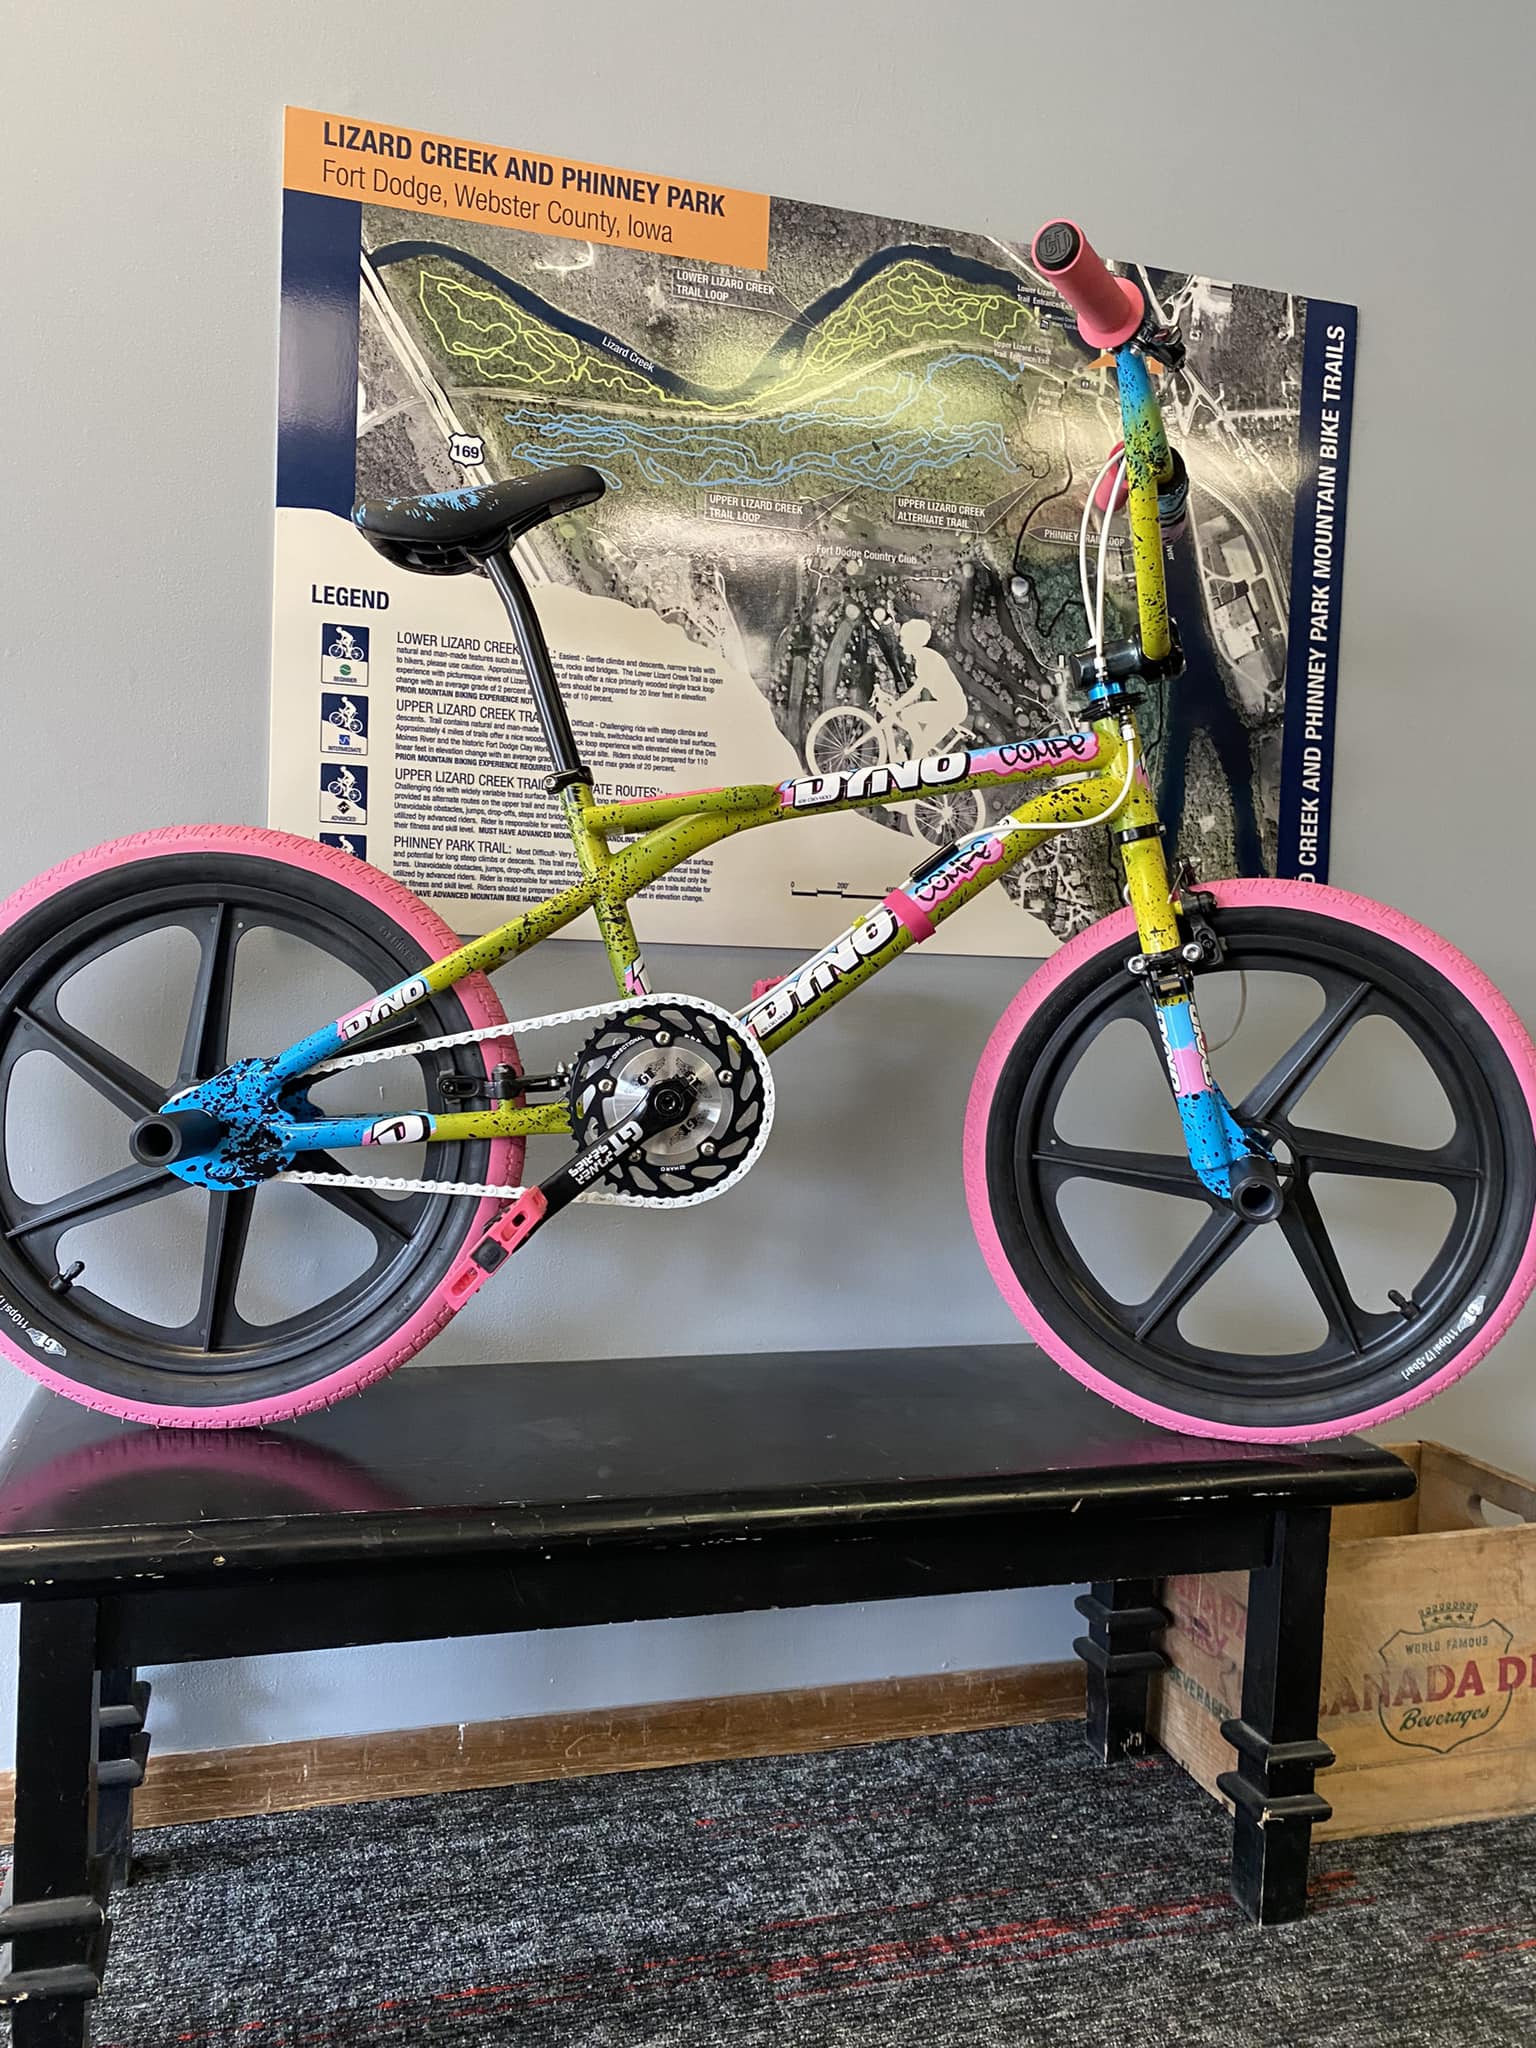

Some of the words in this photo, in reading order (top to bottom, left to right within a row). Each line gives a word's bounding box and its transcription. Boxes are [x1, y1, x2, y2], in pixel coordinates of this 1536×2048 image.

[324, 121, 412, 160] LIZARD
[421, 141, 498, 177] CREEK
[505, 157, 553, 186] AND
[562, 167, 660, 204] PHINNEY
[667, 186, 726, 217] PARK
[323, 159, 365, 189] Fort
[374, 168, 447, 208] Dodge,
[455, 183, 540, 220] Webster
[547, 200, 620, 238] County,
[628, 214, 672, 243] Iowa
[677, 270, 708, 285] LOWER
[711, 277, 743, 290] LIZARD
[746, 282, 775, 296] CREEK
[677, 285, 702, 297] TRAIL
[705, 289, 729, 301] LOOP
[602, 336, 629, 357] Lizard
[629, 353, 655, 373] Creek
[1323, 325, 1346, 402] TRAILS
[1319, 409, 1339, 460] BIKE
[453, 445, 479, 459] 169
[710, 494, 738, 507] UPPER
[741, 498, 772, 511] LIZARD
[774, 503, 803, 515] CREEK
[710, 508, 735, 519] TRAIL
[737, 512, 761, 523] LOOP
[898, 498, 926, 510] UPPER
[928, 502, 957, 514] LIZARD
[958, 506, 986, 517] CREEK
[898, 511, 944, 526] ALTERNATE
[946, 517, 970, 529] TRAIL
[1312, 465, 1337, 579] MOUNTAIN
[1044, 529, 1079, 541] PHINNEY
[1108, 537, 1124, 546] OOP
[817, 544, 832, 554] Fort
[836, 546, 862, 559] Dodge
[864, 550, 896, 564] Country
[898, 553, 917, 564] Club
[312, 584, 390, 610] LEGEND
[1310, 584, 1331, 642] PARK
[397, 632, 437, 646] LOWER
[441, 636, 480, 651] LIZARD
[484, 641, 520, 655] CREEK
[396, 686, 416, 694] PRIOR
[418, 687, 453, 697] MOUNTAIN
[455, 691, 477, 700] BIKING
[479, 693, 519, 704] EXPERIENCE
[1305, 647, 1327, 740] PHINNEY
[396, 699, 433, 714] UPPER
[437, 703, 476, 717] LIZARD
[480, 706, 516, 721] CREEK
[395, 723, 440, 735] Approximately
[448, 728, 464, 736] miles
[473, 730, 488, 738] trails
[600, 721, 633, 733] Challenging
[395, 734, 418, 742] Moines
[420, 735, 435, 743] River
[462, 739, 484, 747] historic
[500, 742, 518, 751] Dodge
[520, 744, 532, 752] Clay
[1000, 735, 1086, 766] COMPE
[395, 753, 416, 761] PRIOR
[417, 755, 453, 764] MOUNTAIN
[454, 758, 477, 766] BIKING
[479, 760, 518, 770] EXPERIENCE
[1302, 747, 1322, 792] AND
[395, 768, 432, 782] UPPER
[435, 771, 475, 785] LIZARD
[479, 774, 514, 788] CREEK
[794, 752, 970, 806] DYNO
[395, 782, 431, 793] Challenging
[461, 788, 481, 797] widely
[482, 789, 506, 797] variable
[524, 792, 546, 800] surface
[478, 827, 497, 835] MUST
[499, 828, 515, 836] HAVE
[518, 829, 551, 838] ADVANCED
[1298, 797, 1319, 866] CREEK
[394, 836, 443, 850] PHINNEY
[446, 839, 475, 852] PARK
[478, 841, 512, 854] TRAIL:
[433, 891, 469, 900] ADVANCED
[470, 893, 504, 901] MOUNTAIN
[506, 894, 521, 902] BIKE
[752, 908, 898, 1040] DYNO
[342, 980, 428, 1039] DYNO
[608, 1121, 644, 1157] GT
[568, 1144, 609, 1178] SERIES
[575, 1150, 614, 1185] POWER
[1432, 1328, 1459, 1354] 110psi
[1405, 1640, 1440, 1654] WORLD
[1446, 1636, 1489, 1650] FAMOUS
[1400, 1705, 1490, 1732] Beverages
